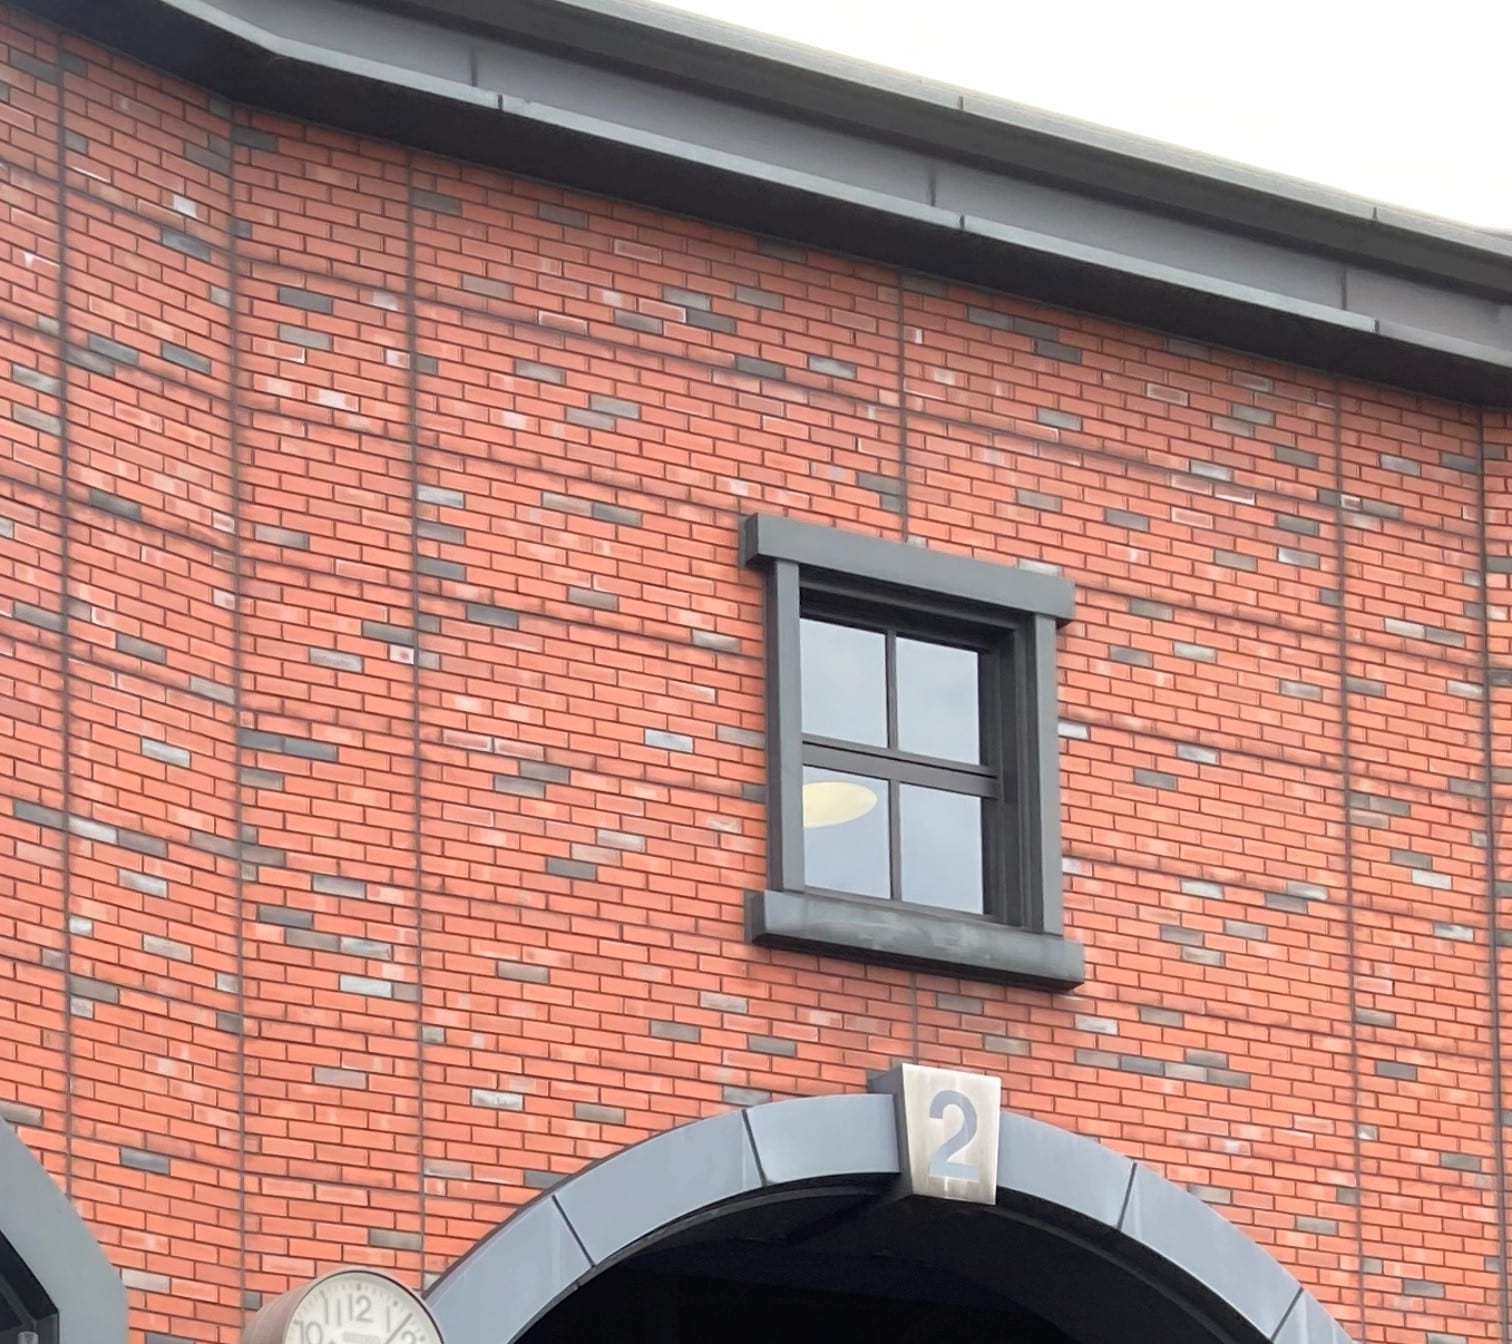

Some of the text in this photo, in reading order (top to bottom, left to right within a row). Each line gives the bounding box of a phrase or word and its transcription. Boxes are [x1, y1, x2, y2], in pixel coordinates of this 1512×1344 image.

[928, 1089, 981, 1183] 2
[323, 1297, 341, 1327] 11
[349, 1293, 373, 1323] 12
